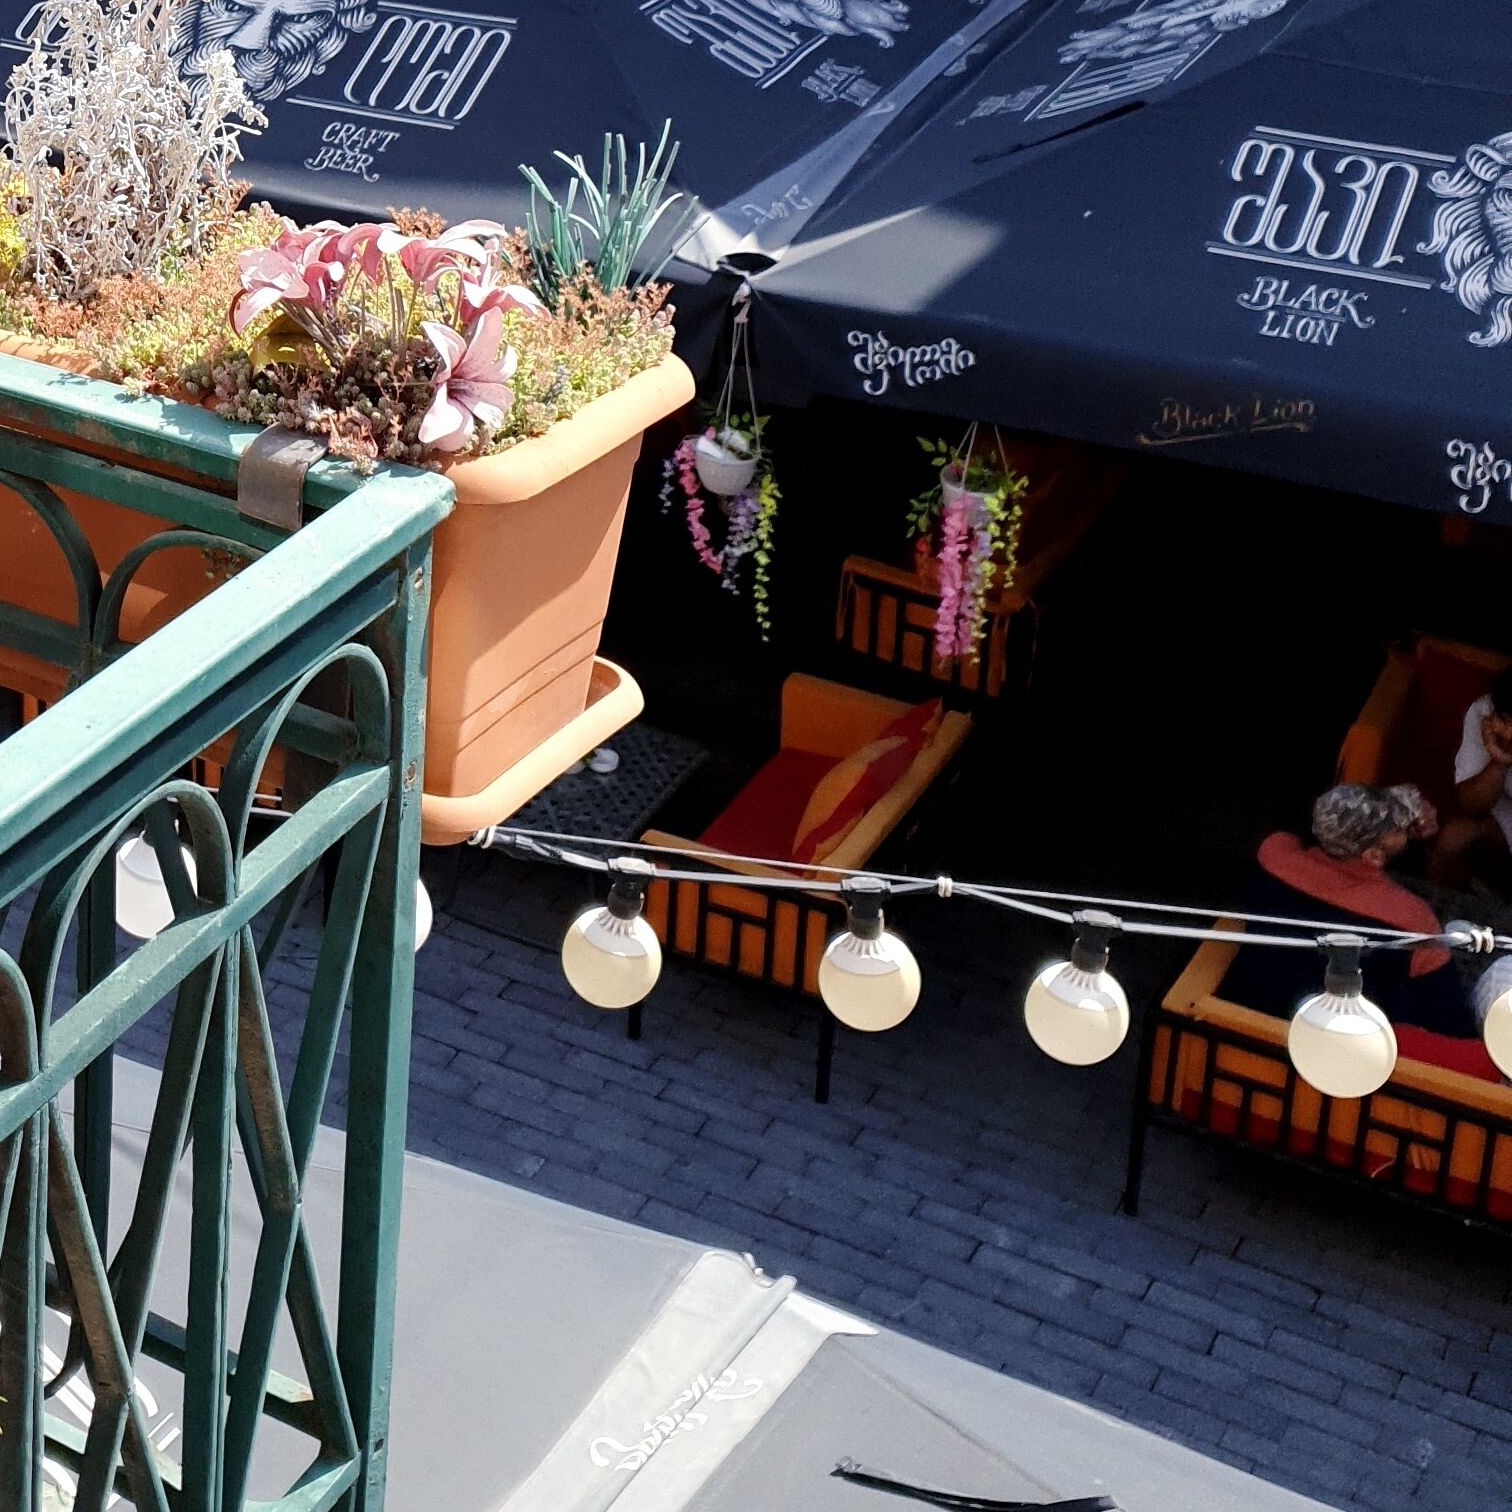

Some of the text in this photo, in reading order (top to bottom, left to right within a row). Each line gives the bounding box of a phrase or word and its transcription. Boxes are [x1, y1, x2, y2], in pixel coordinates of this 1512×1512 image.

[322, 122, 400, 156] CRAFT
[306, 147, 381, 183] BEER
[1222, 138, 1419, 268] შავი
[1237, 276, 1376, 328] BLACK
[1259, 311, 1342, 347] LION
